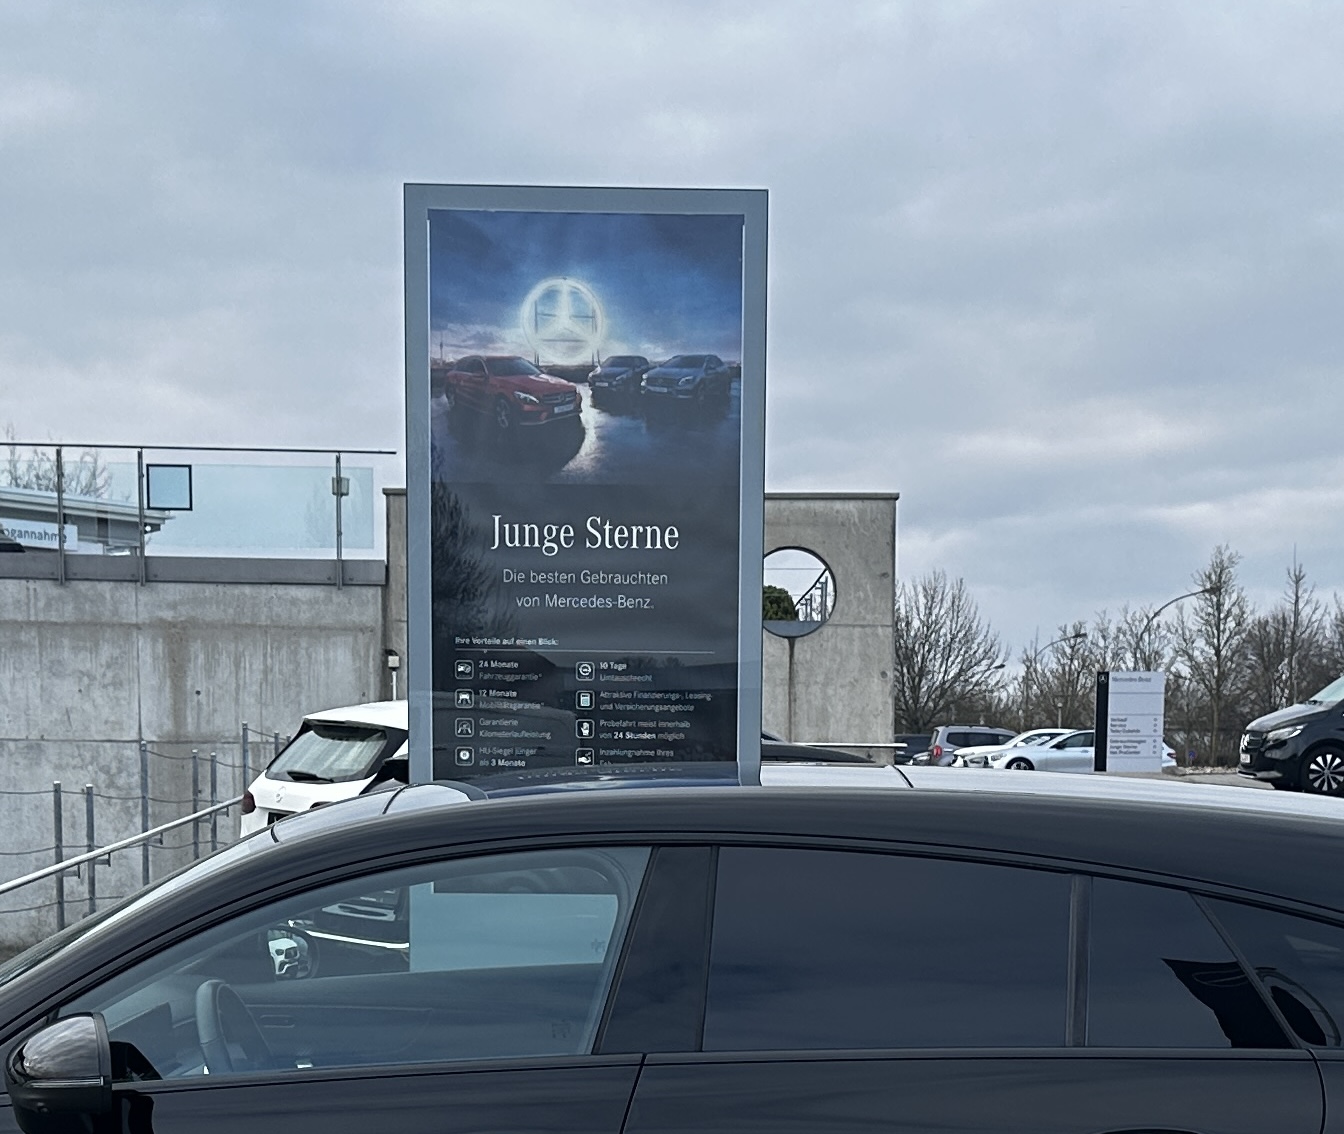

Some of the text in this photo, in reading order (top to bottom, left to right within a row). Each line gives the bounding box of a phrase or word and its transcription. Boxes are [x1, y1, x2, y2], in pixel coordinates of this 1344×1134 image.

[491, 515, 679, 556] Junge Sterne
[503, 569, 668, 585] Die besten Gebrauchten
[516, 593, 655, 609] von Mercedes-Benz.
[502, 637, 515, 645] auf
[610, 662, 627, 671] Tage
